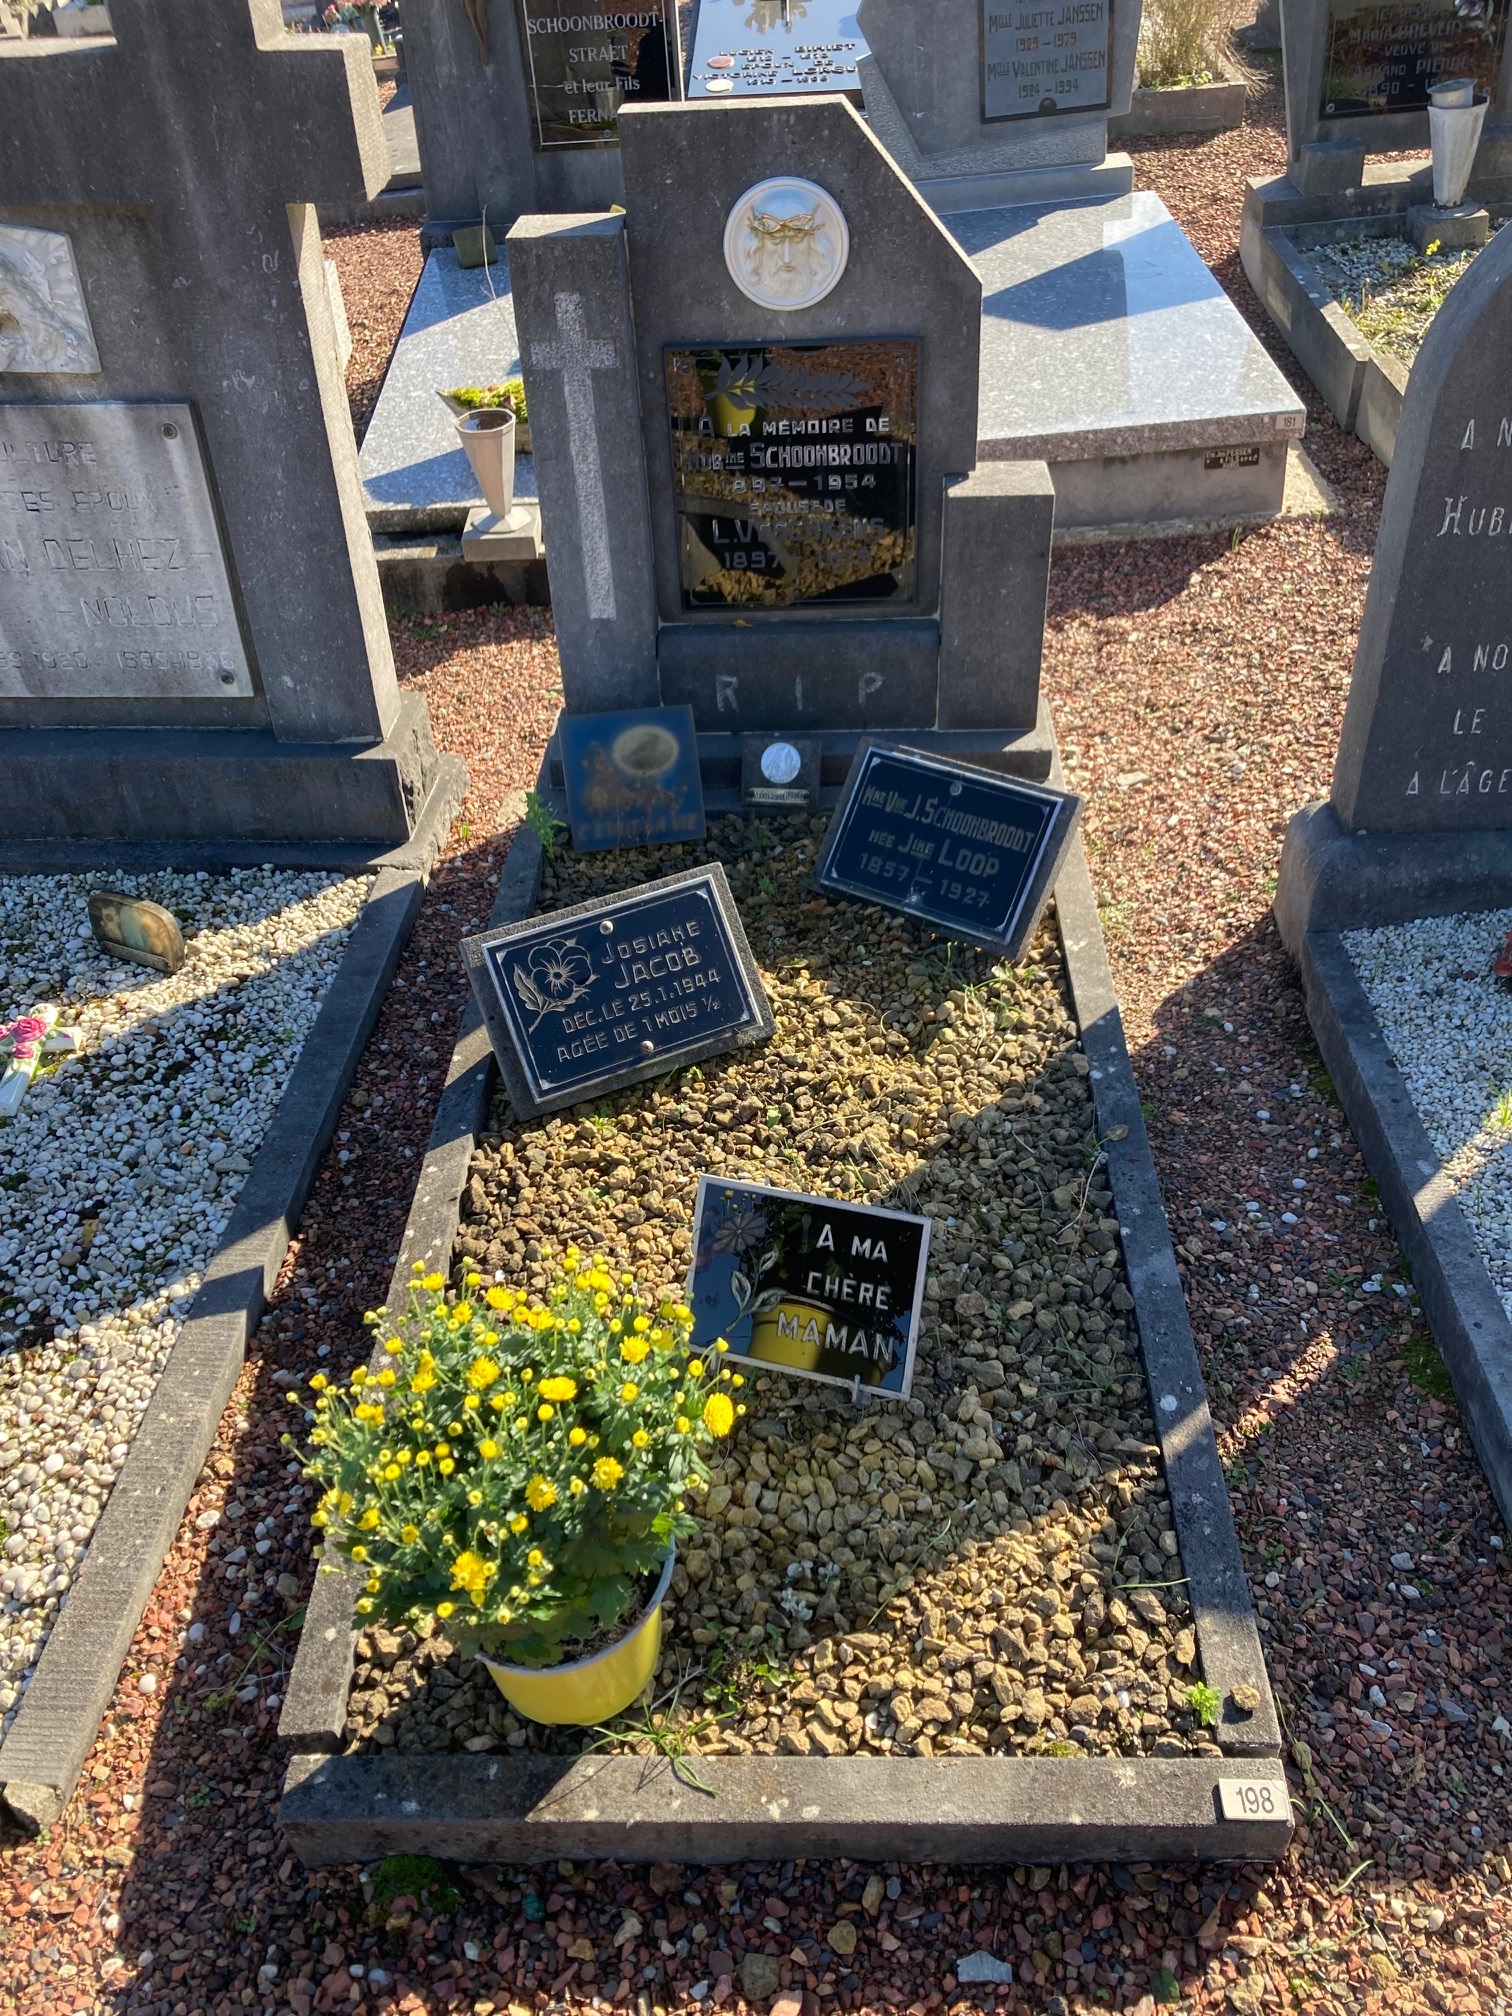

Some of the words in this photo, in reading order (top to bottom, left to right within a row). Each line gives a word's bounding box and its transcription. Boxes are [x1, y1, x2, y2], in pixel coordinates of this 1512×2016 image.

[528, 12, 663, 34] SCHOONBROODT-
[1015, 11, 1055, 30] JULIETTE
[1057, 2, 1104, 26] JANSSEN
[569, 44, 628, 63] STRAET
[1053, 32, 1077, 47] 1979
[1012, 58, 1059, 78] VALENTINE
[1060, 50, 1106, 73] JANSSEN
[564, 82, 578, 94] et
[582, 79, 610, 93] leur
[615, 75, 640, 91] Fils
[698, 416, 715, 437] A
[726, 423, 751, 437] LA
[762, 418, 854, 436] MÉMOIRE
[865, 416, 890, 432] DE
[1282, 416, 1297, 428] 181
[1460, 418, 1475, 450] A
[749, 442, 903, 468] SCHOONBROODT
[813, 474, 877, 491] 1954
[2, 491, 55, 513] DES
[71, 490, 156, 513] EPOUX
[824, 499, 846, 513] DE
[1436, 495, 1512, 537] HUB
[722, 550, 781, 569] 1897
[1437, 646, 1451, 674] A
[715, 674, 739, 712] R
[794, 674, 803, 712] I
[858, 671, 884, 706] P
[1452, 708, 1486, 735] LE
[1405, 770, 1419, 796] A
[937, 839, 1000, 878] LOOP
[858, 853, 910, 882] 1857
[938, 878, 990, 908] 1927
[601, 920, 701, 965] JOSIANE
[613, 945, 703, 989] JACOB
[628, 968, 721, 1013] 25.1.1944
[613, 1021, 639, 1043] DE
[656, 1002, 699, 1028] MOIS
[815, 1223, 835, 1252] A
[851, 1235, 888, 1263] MA
[806, 1270, 892, 1311] CHÈRE
[777, 1311, 894, 1363] MAMAN
[1236, 1786, 1275, 1814] 198
